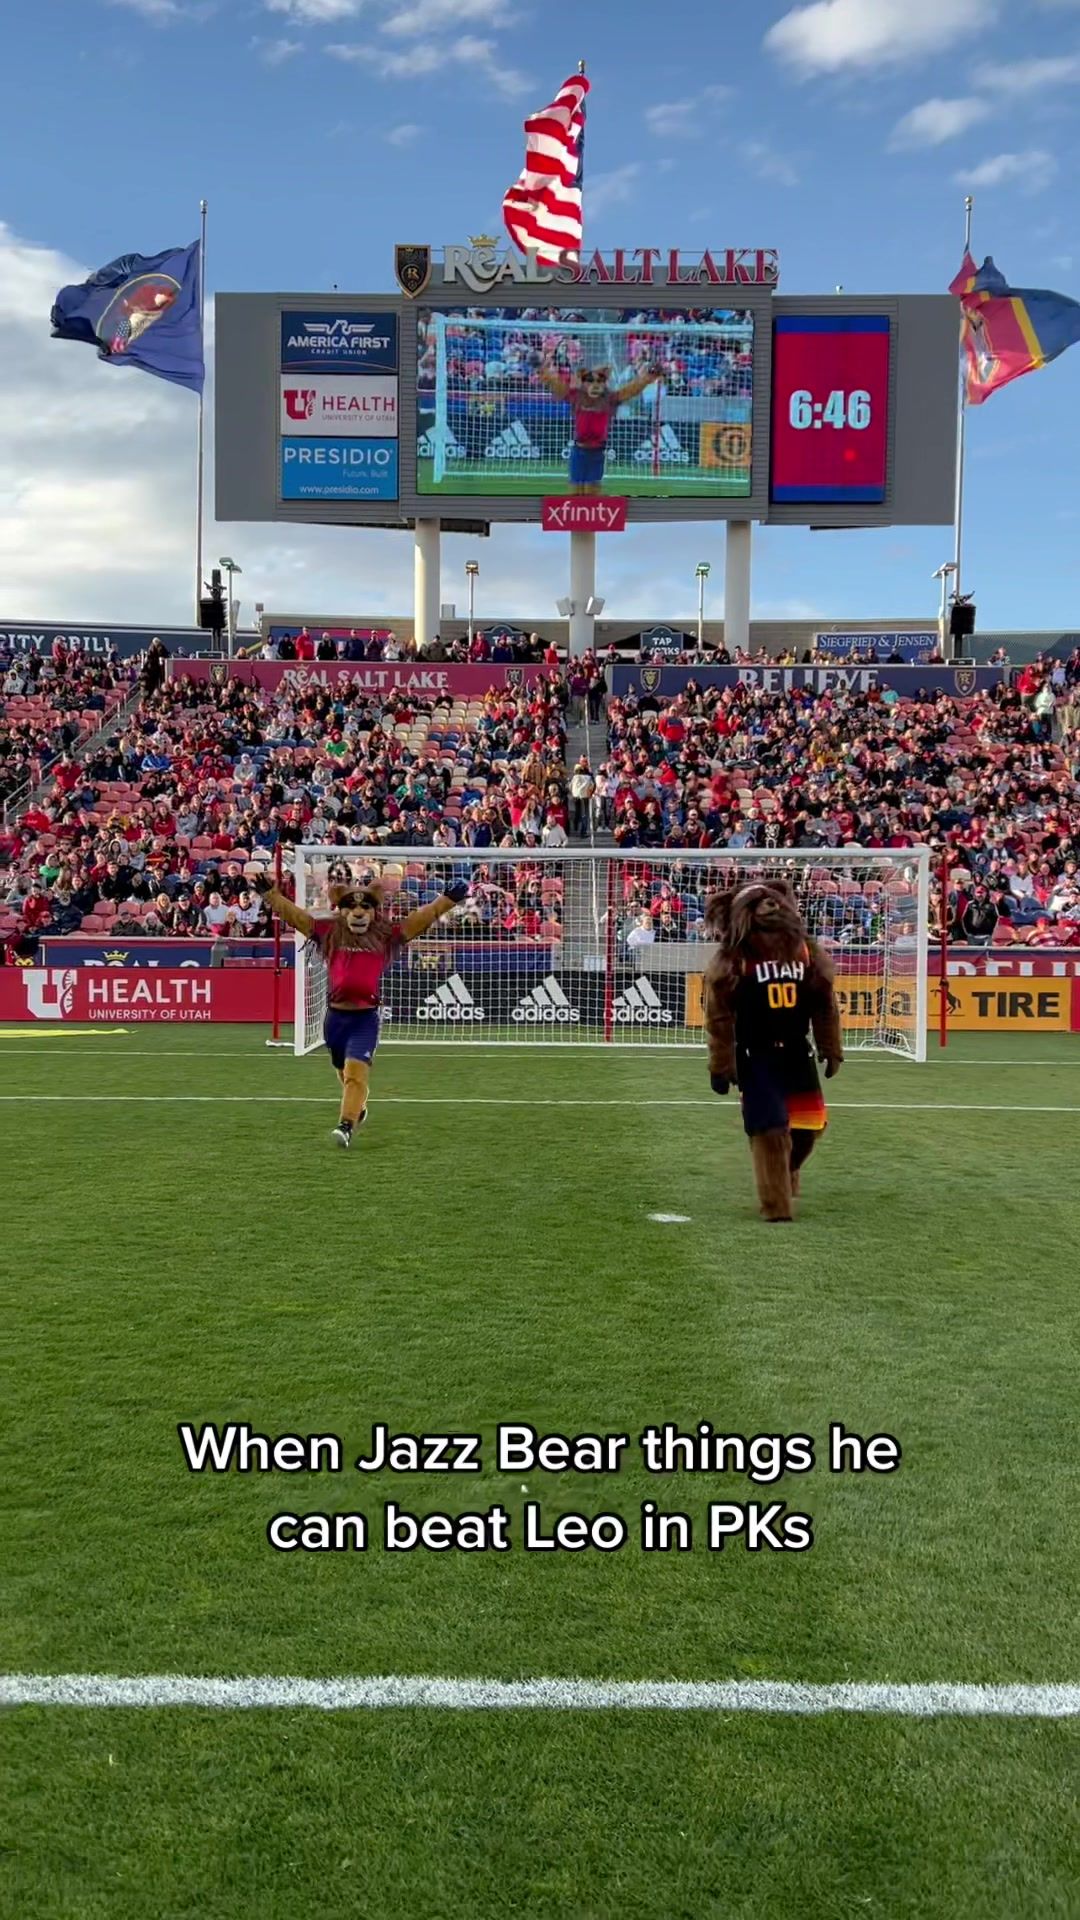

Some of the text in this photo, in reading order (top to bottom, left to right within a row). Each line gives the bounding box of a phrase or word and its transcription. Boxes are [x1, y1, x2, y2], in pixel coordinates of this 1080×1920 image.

[556, 248, 661, 284] SALT
[666, 248, 779, 285] LAKE
[287, 335, 391, 349] AMERICA FIRST
[322, 395, 396, 412] HEALTH
[789, 389, 871, 430] 6:46
[284, 447, 391, 465] PRESIDIO
[485, 443, 541, 459] adidas
[300, 485, 379, 495] www.presidio.com
[547, 500, 620, 528] xfinity
[652, 637, 673, 646] TAP
[819, 635, 935, 648] SIEGFRIED & JENSEN
[338, 670, 389, 688] SALT
[394, 671, 449, 688] LAKE
[755, 960, 804, 983] UTAH
[88, 979, 212, 1003] HEALTH
[767, 982, 797, 1009] 00
[416, 1002, 486, 1020] adidas
[511, 1003, 581, 1021] adidas
[971, 991, 1060, 1018] TIRE
[88, 1009, 212, 1020] UNIVERSITY OF UTAH
